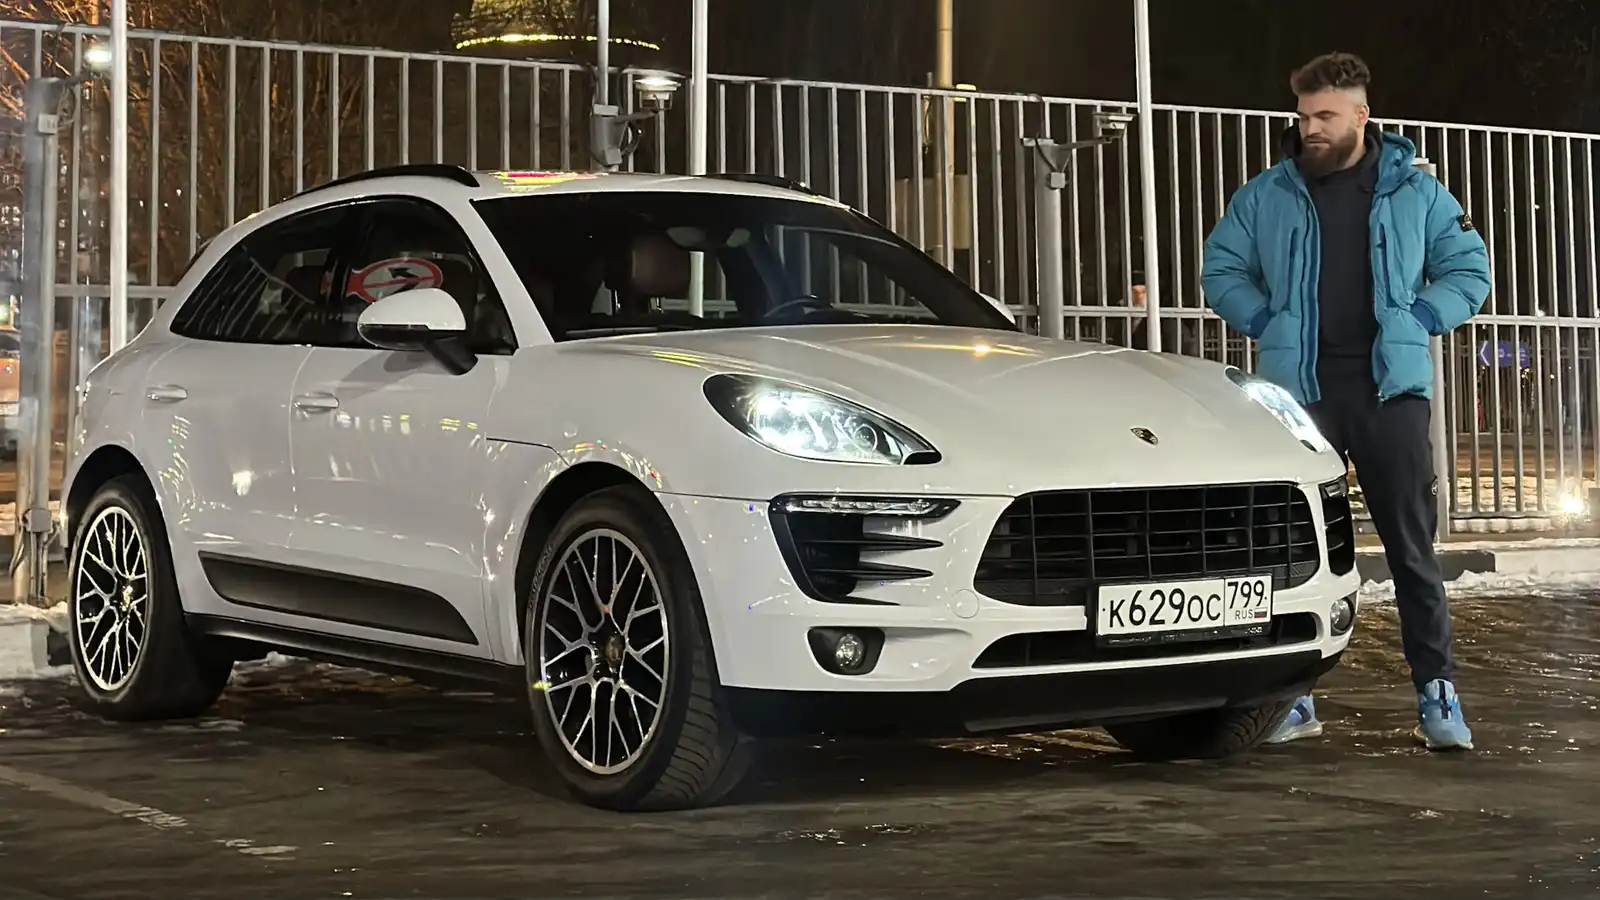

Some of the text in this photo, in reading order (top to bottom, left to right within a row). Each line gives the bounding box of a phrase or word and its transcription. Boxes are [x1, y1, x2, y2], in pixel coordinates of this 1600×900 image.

[1109, 580, 1265, 628] К629ОС 799
[1235, 608, 1254, 621] RUS
